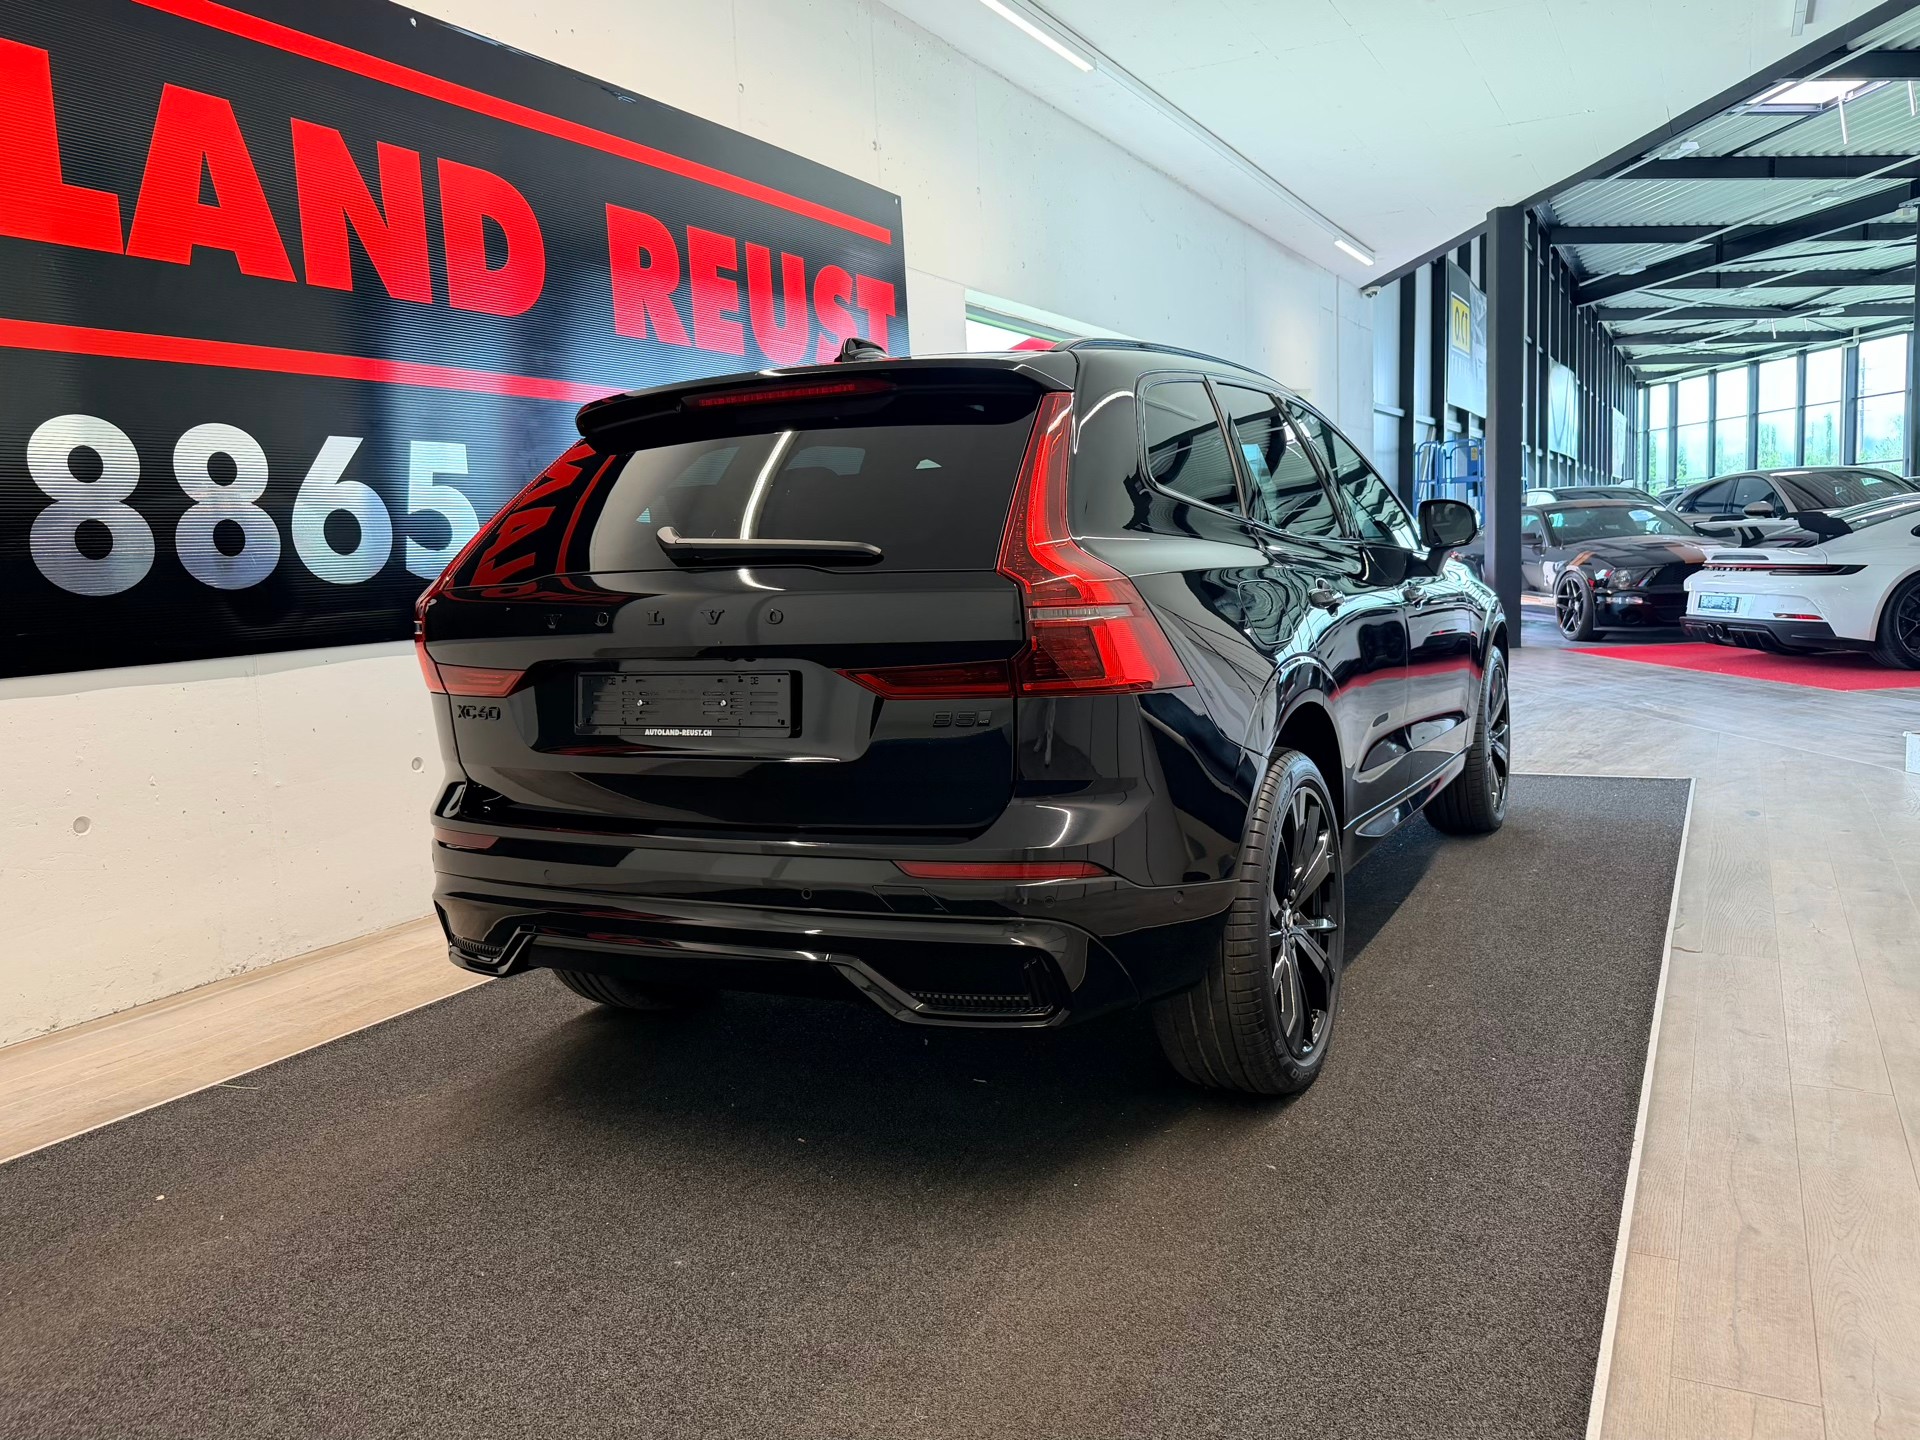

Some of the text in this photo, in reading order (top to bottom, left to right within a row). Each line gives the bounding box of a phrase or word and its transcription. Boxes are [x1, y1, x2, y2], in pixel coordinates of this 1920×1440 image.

[0, 38, 897, 365] LAND REUST
[26, 414, 482, 596] 8865
[543, 608, 785, 629] VOLVO
[457, 704, 502, 720] XC60
[644, 728, 713, 737] AUTOLAND-REUST.CH
